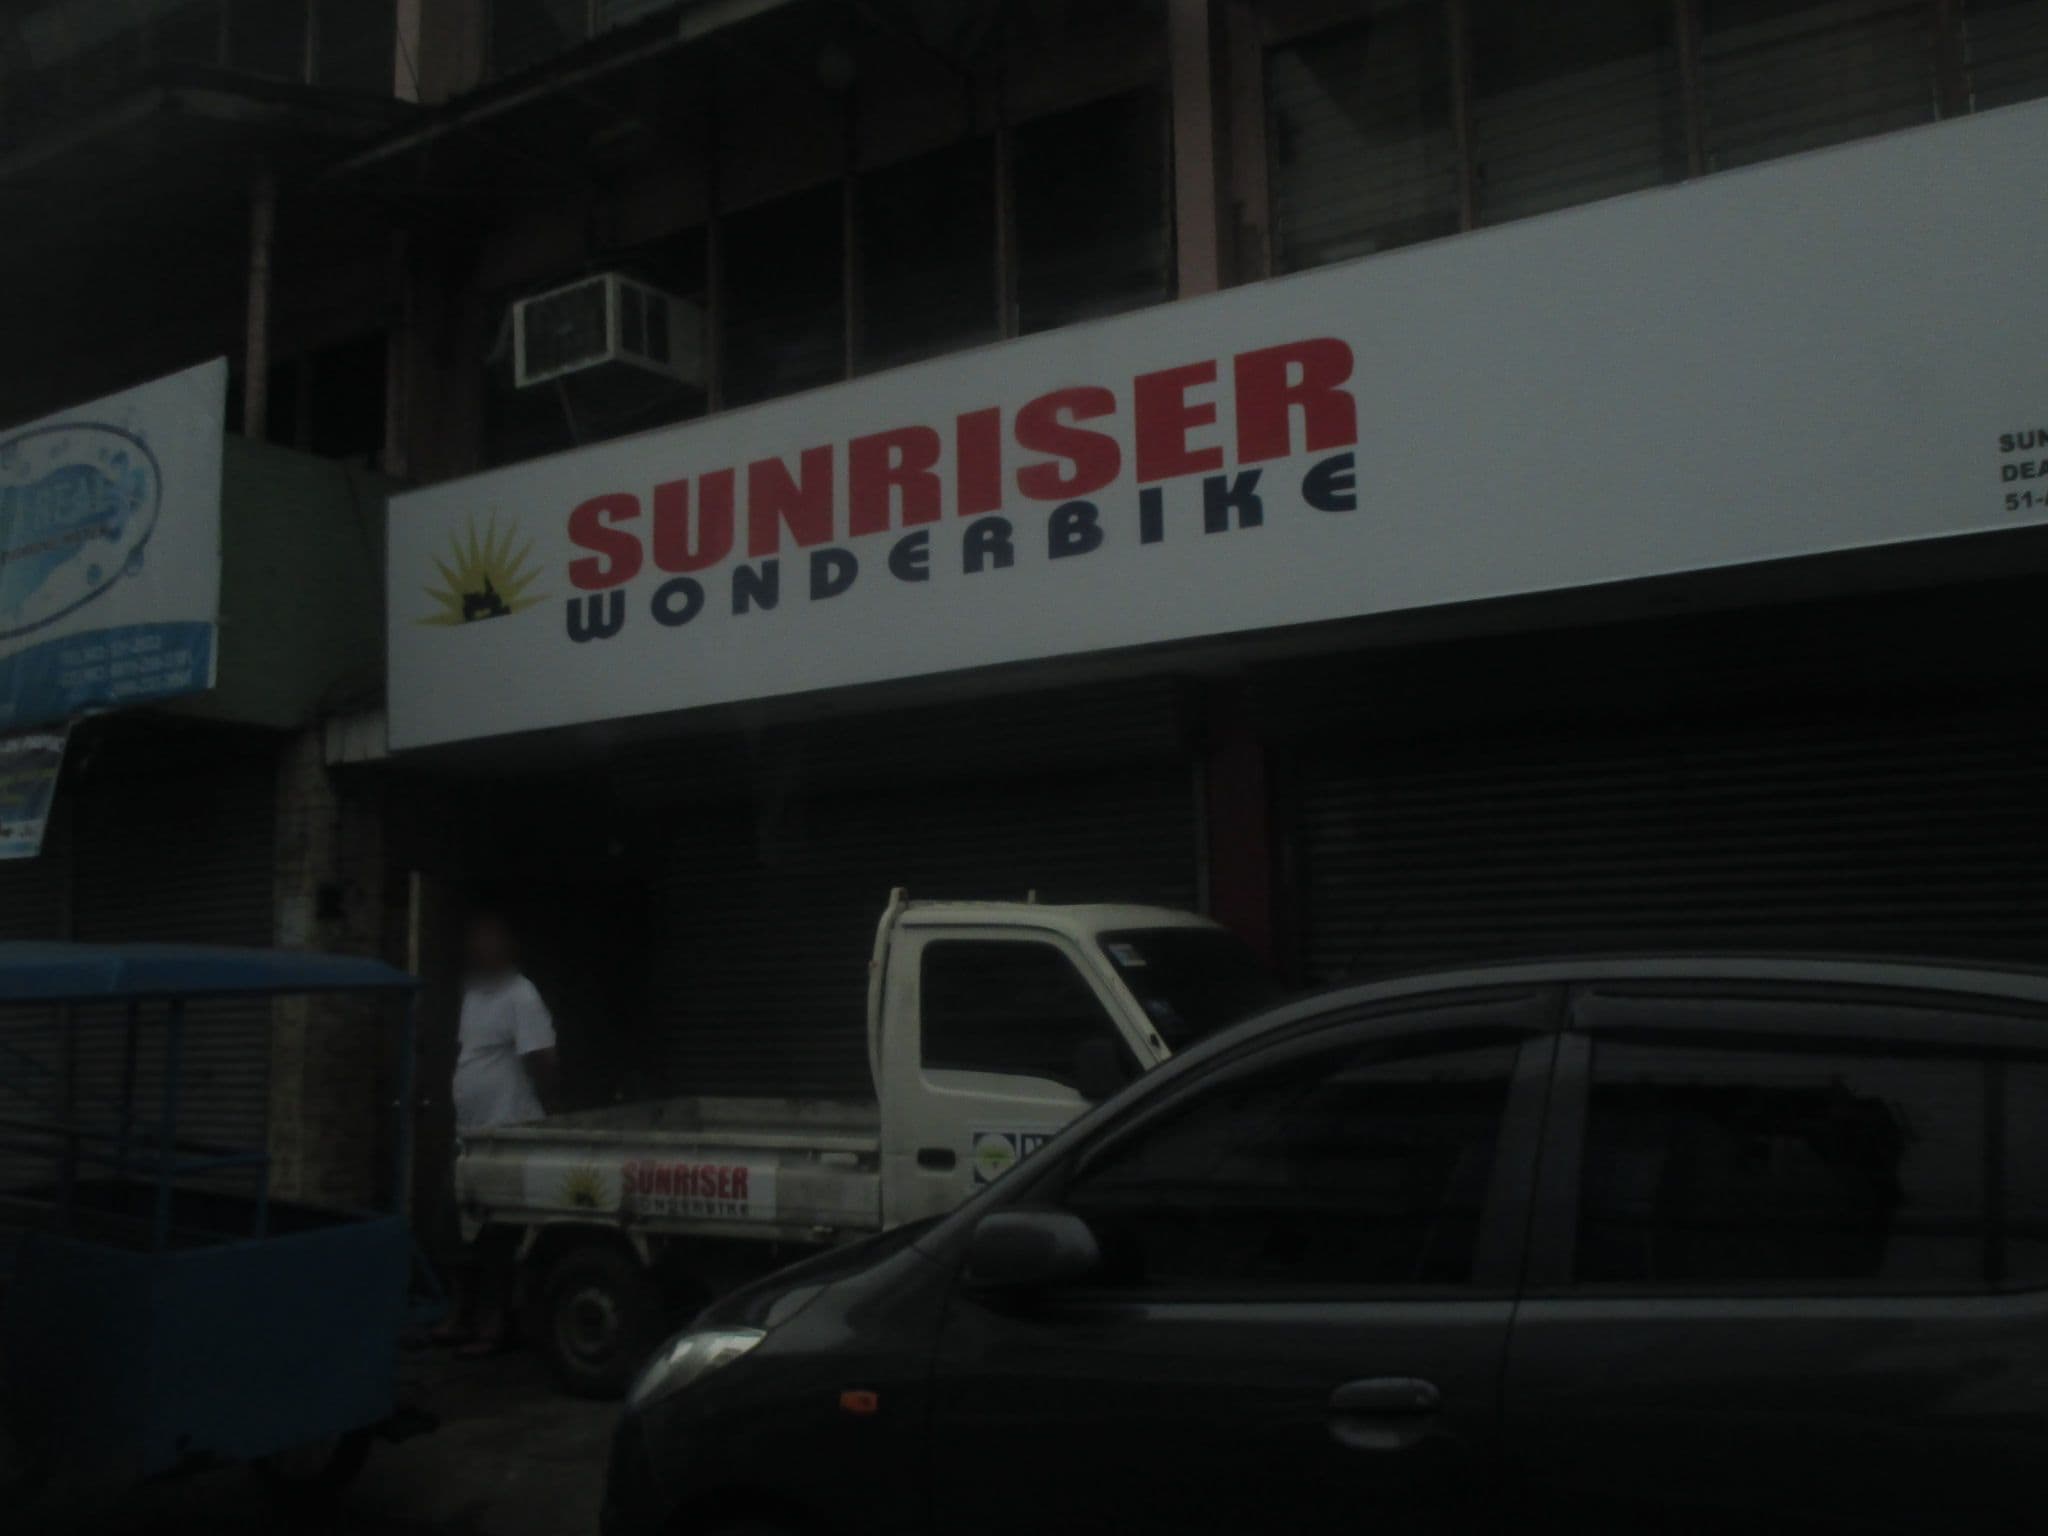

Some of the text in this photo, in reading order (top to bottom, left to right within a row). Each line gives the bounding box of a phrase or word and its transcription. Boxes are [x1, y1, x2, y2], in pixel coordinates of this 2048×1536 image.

[567, 338, 1358, 589] SUNRISER
[2005, 490, 2048, 512] 51-
[566, 452, 1358, 643] WONDERBIKE
[622, 1160, 748, 1200] SUNRISER
